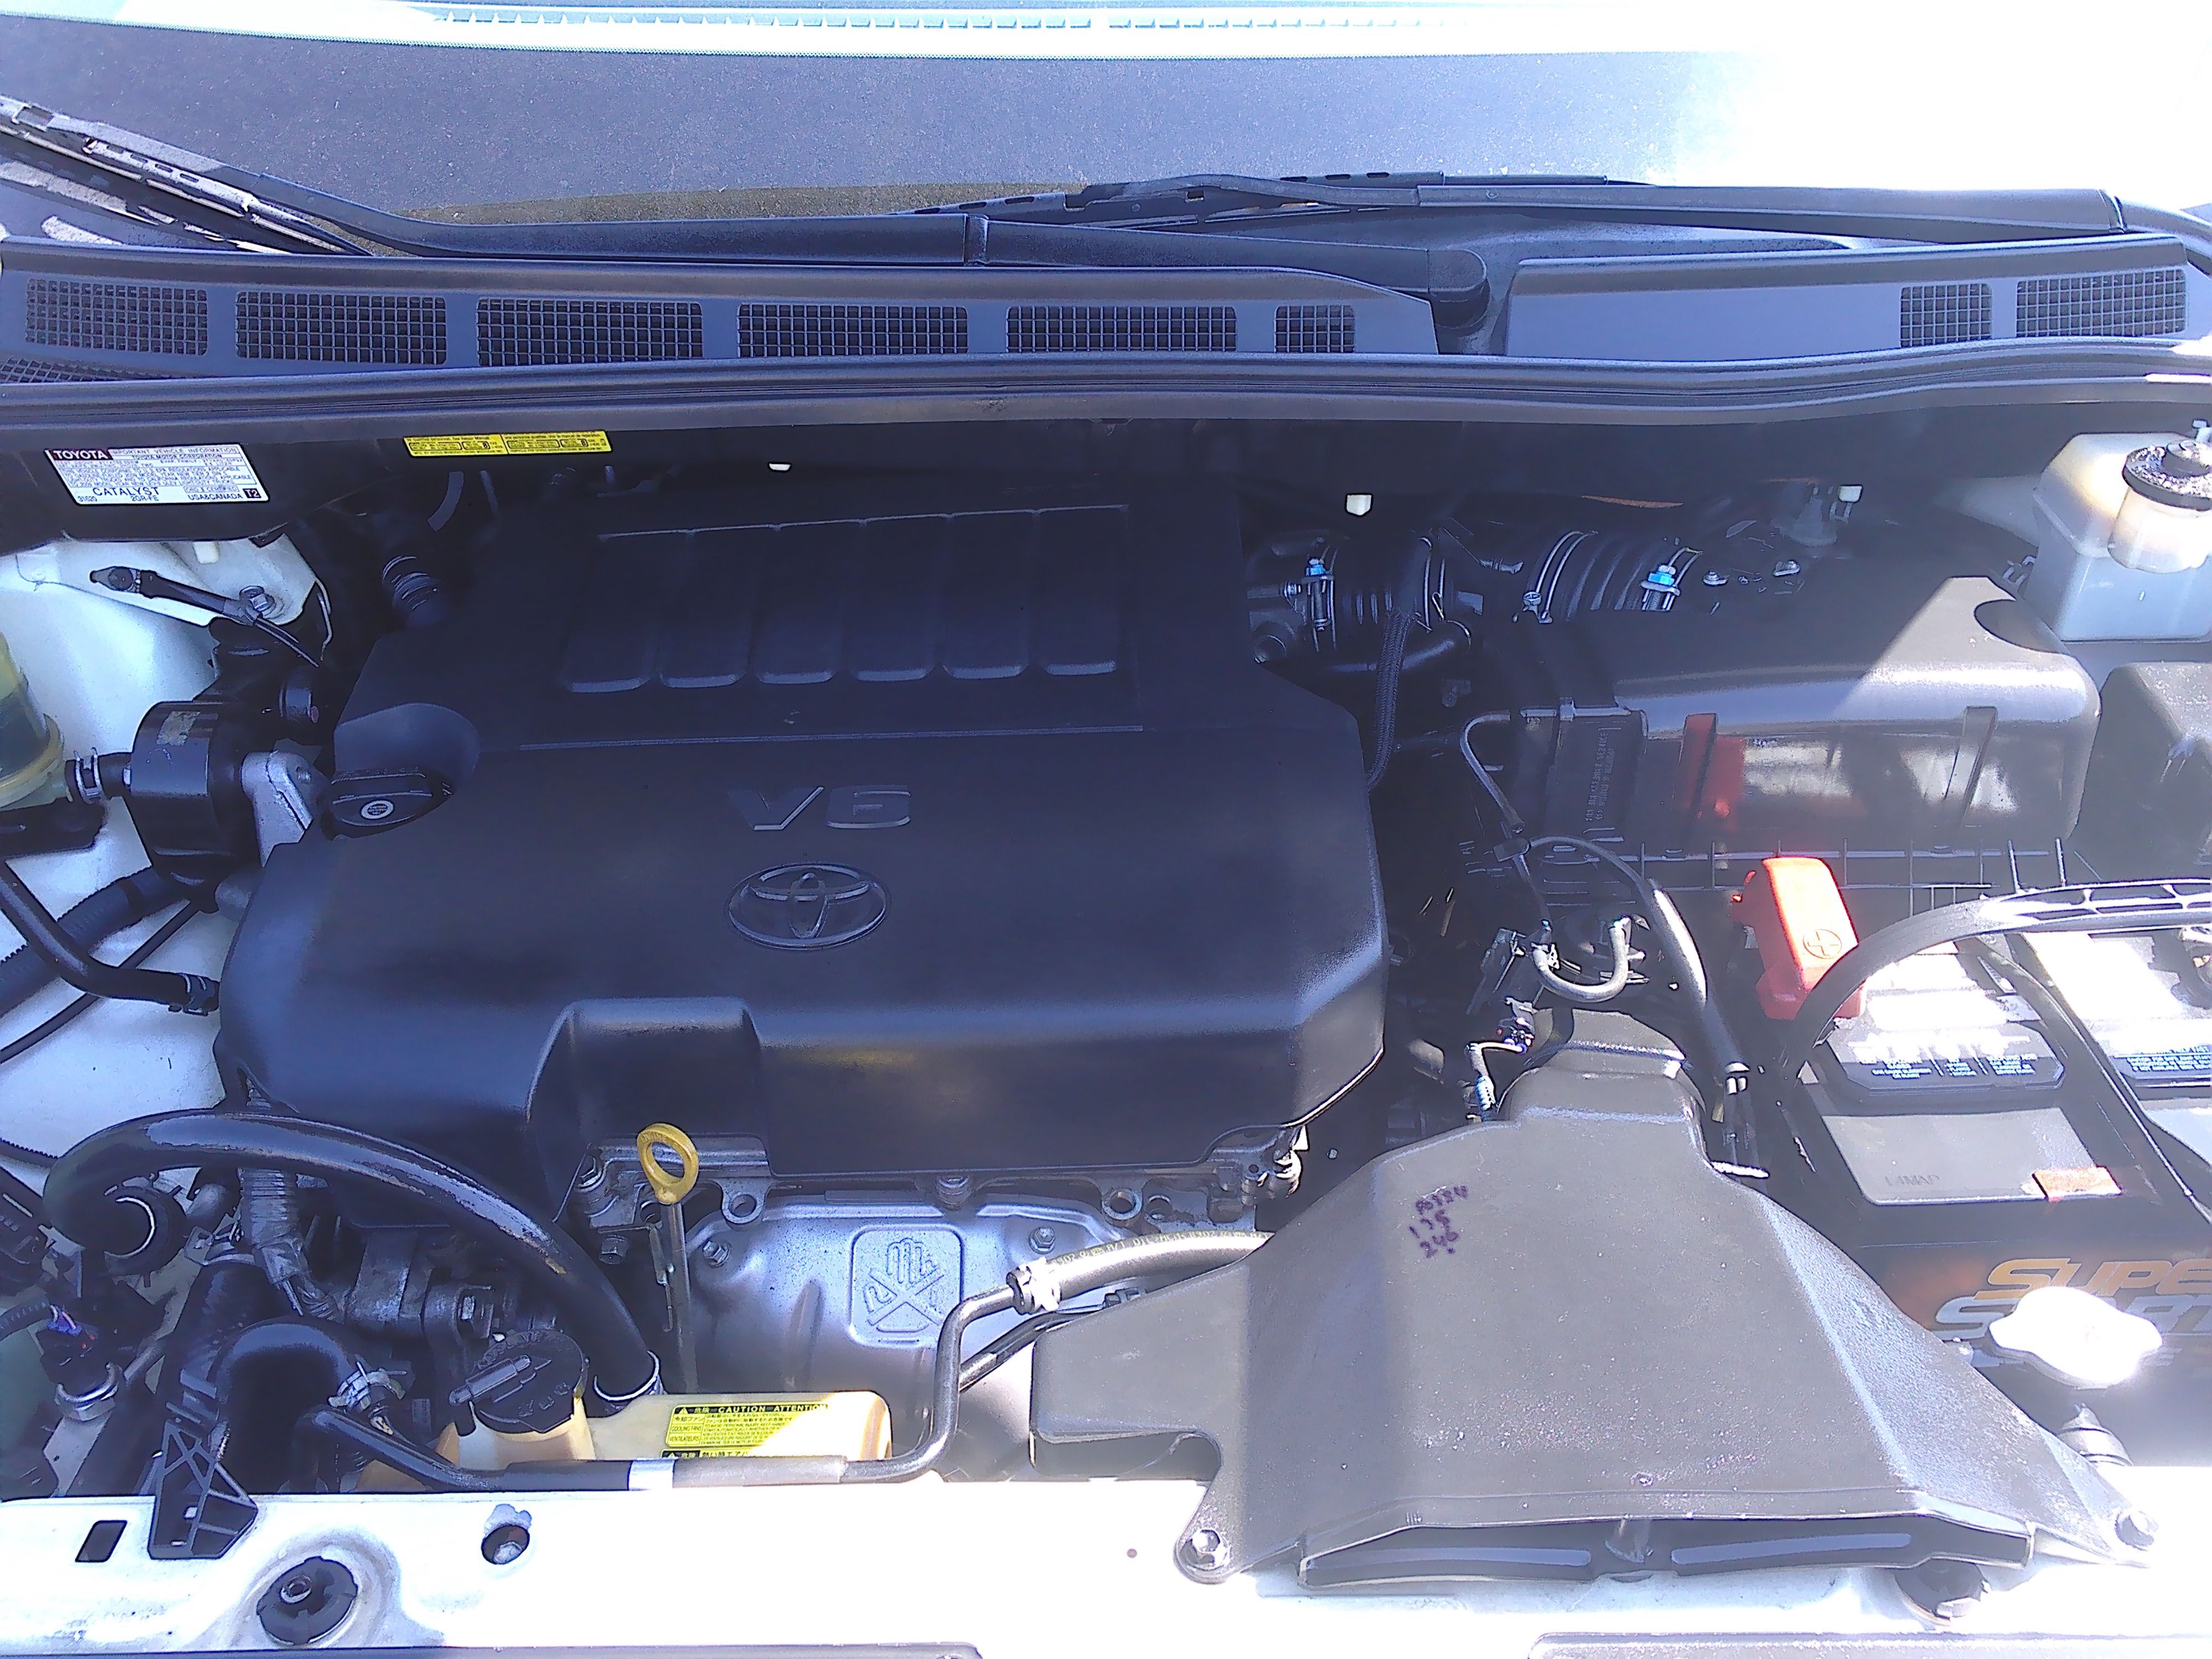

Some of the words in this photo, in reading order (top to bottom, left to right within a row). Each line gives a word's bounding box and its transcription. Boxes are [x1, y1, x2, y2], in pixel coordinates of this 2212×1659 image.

[54, 450, 108, 460] TOYOTA
[92, 487, 159, 496] CATALYST
[246, 489, 259, 498] T2
[187, 492, 243, 501] USA&CANADA
[727, 784, 911, 830] V6
[774, 1404, 827, 1412] ATTENTION
